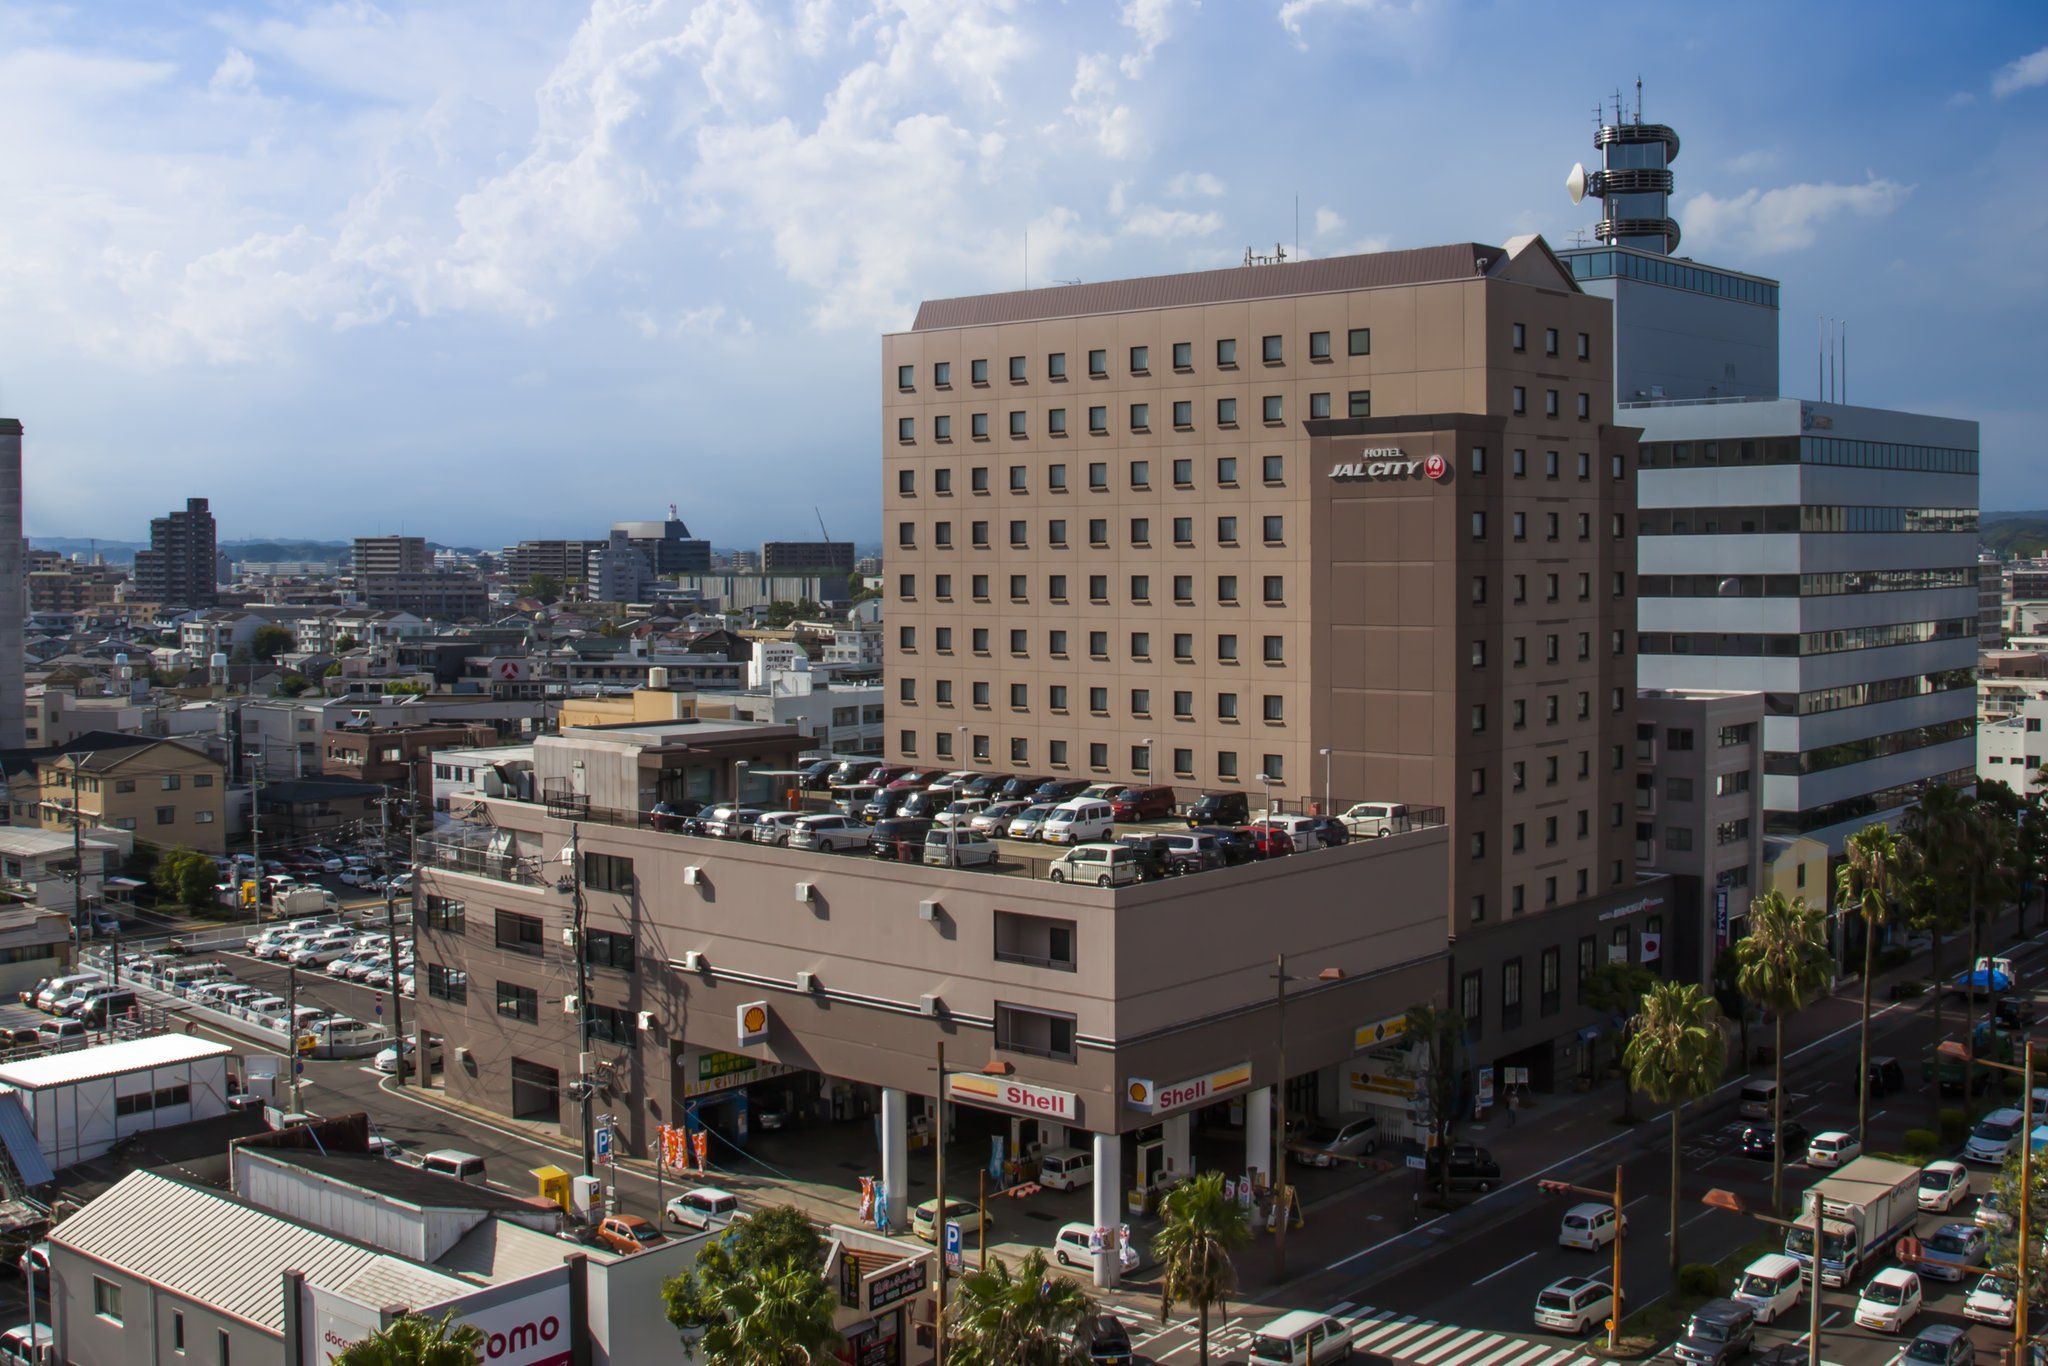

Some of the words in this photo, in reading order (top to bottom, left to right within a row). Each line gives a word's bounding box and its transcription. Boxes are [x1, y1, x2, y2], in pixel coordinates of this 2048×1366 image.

[1363, 448, 1403, 457] HOTEL
[1007, 1086, 1064, 1113] Shell
[1160, 1080, 1206, 1109] Shell
[599, 1133, 607, 1152] P
[591, 1183, 598, 1195] P
[948, 1226, 958, 1250] P
[472, 1315, 560, 1364] como
